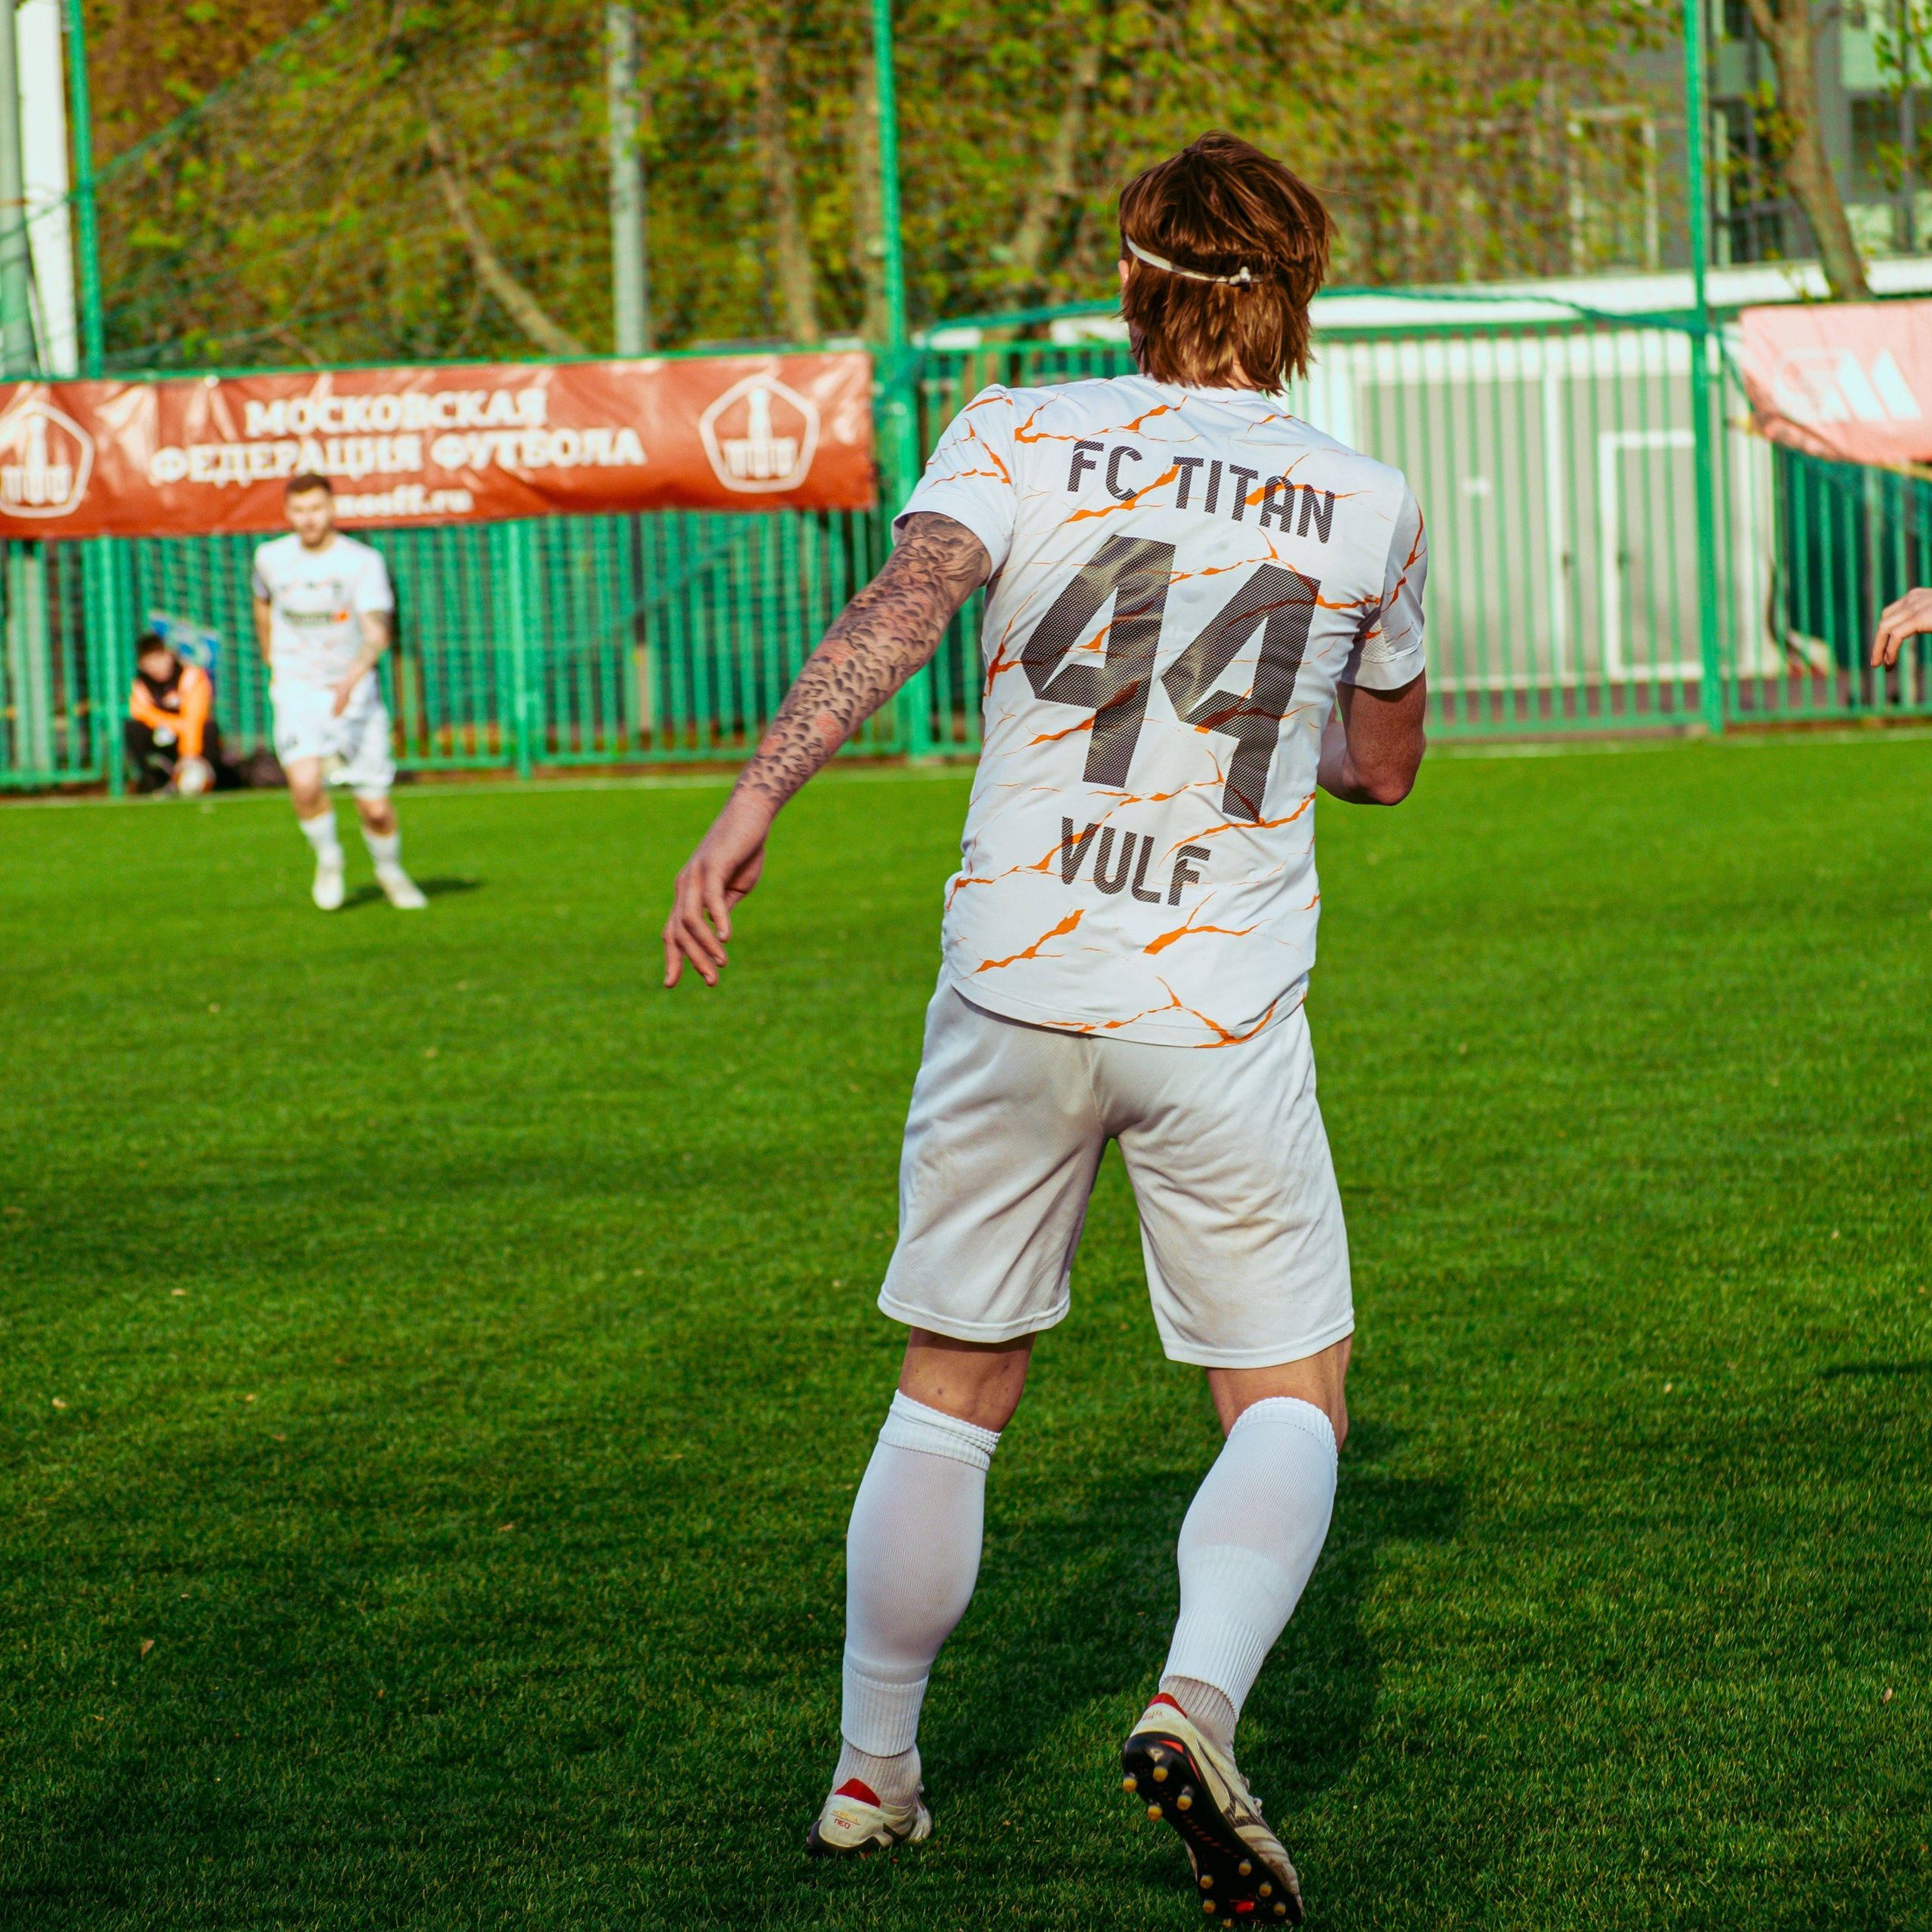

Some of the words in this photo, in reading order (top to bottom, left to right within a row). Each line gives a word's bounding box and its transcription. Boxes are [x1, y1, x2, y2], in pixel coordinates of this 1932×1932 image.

[152, 435, 421, 486] ФЕДЕРАЦИЯ
[431, 428, 646, 470] ФУТБОЛА
[247, 389, 546, 437] МОСКОВСКАЯ
[1066, 440, 1143, 501] FC
[1173, 457, 1335, 544] TITAN
[1020, 534, 1321, 823] 44
[1060, 816, 1211, 906] VULF
